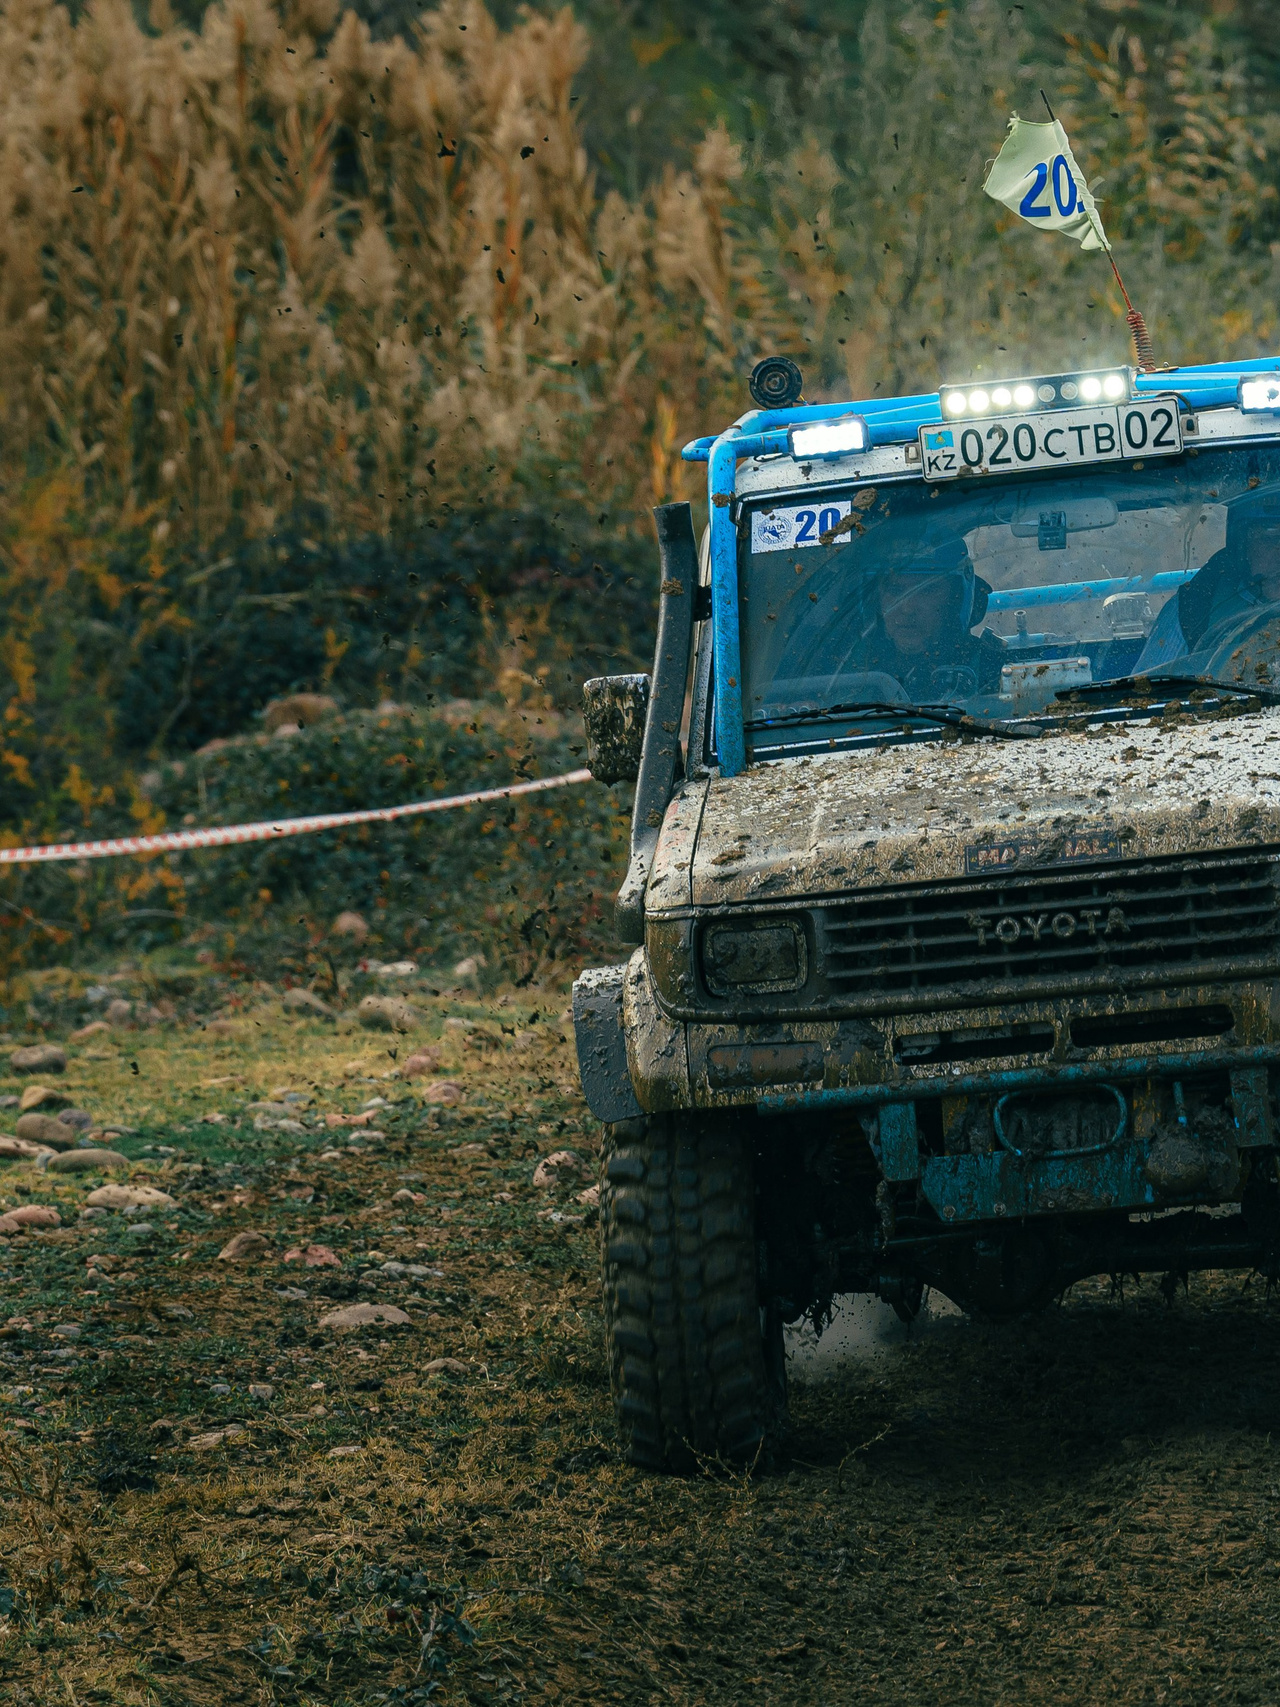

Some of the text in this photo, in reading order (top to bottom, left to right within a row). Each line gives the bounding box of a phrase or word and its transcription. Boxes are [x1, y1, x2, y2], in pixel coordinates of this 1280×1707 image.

[927, 454, 957, 472] KZ
[795, 507, 841, 543] 20
[964, 906, 1131, 947] TOYOTA
